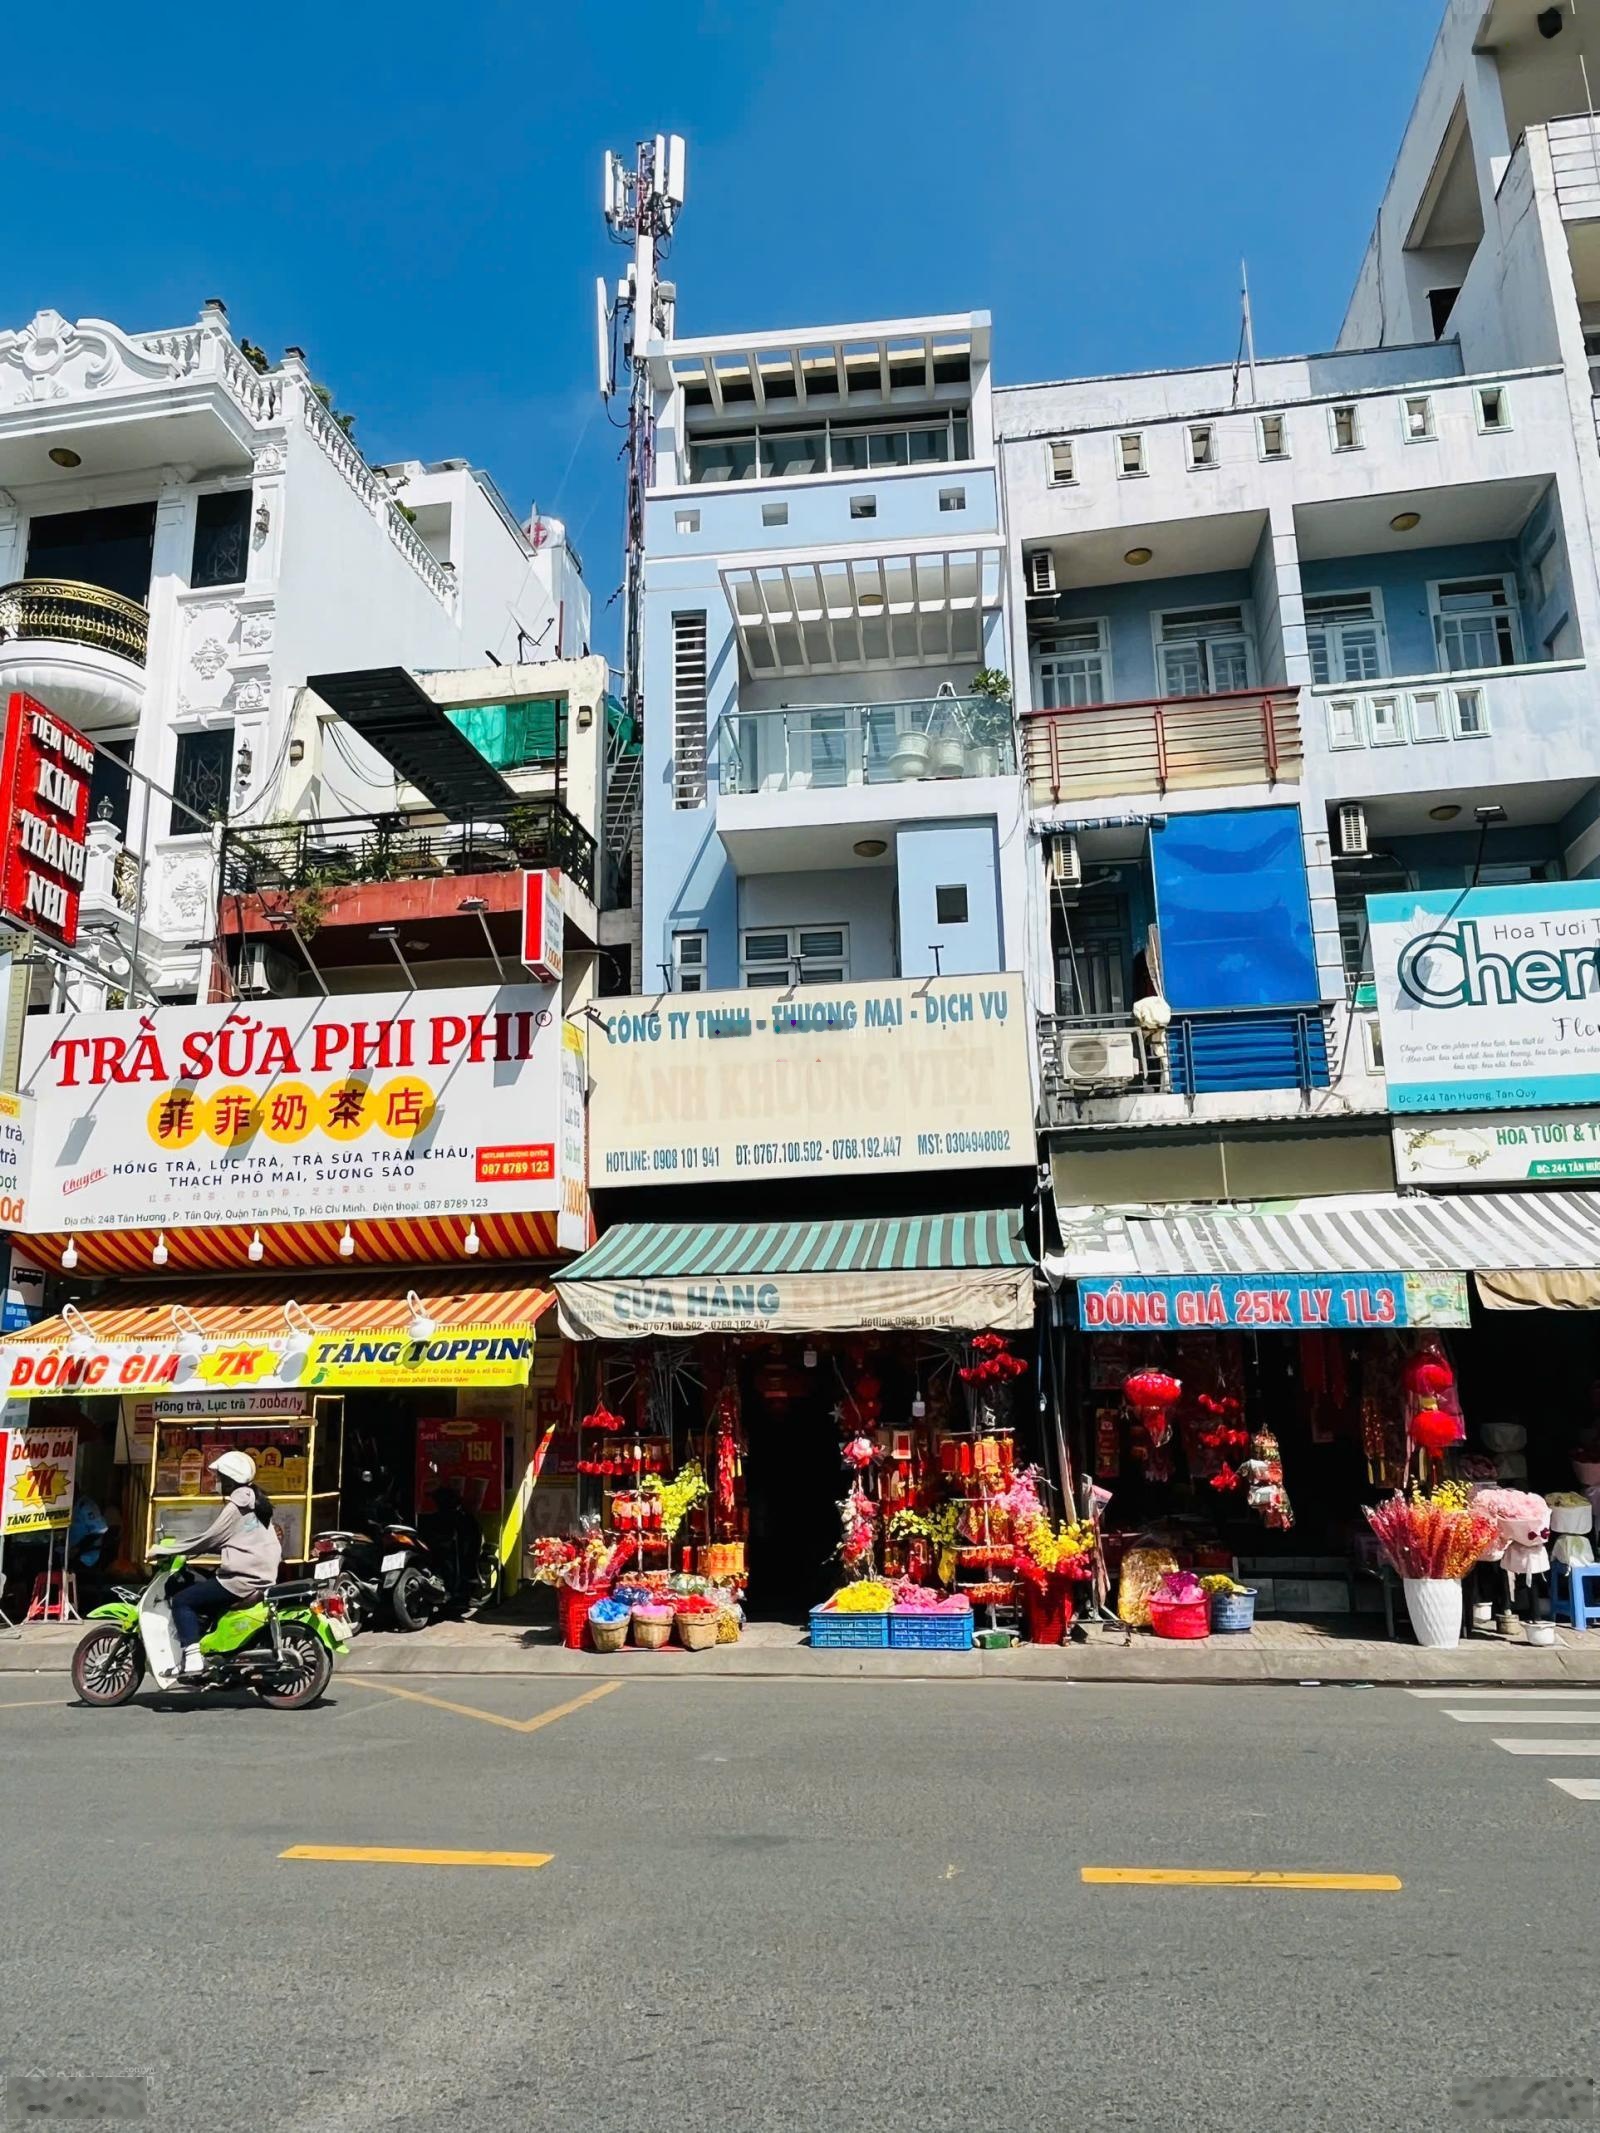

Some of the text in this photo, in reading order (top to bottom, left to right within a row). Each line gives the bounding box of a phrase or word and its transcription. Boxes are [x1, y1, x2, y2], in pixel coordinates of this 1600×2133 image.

[37, 758, 79, 816] KIM
[20, 809, 88, 882] THÀNH
[26, 871, 68, 927] NHI
[1493, 924, 1535, 941] Hoa
[1540, 919, 1587, 938] Tươi
[1397, 920, 1600, 1009] Cher
[606, 1009, 662, 1044] CÔNG
[668, 1012, 691, 1039] TY
[864, 998, 903, 1033] MẠI
[925, 992, 974, 1030] DỊCH
[979, 991, 1009, 1027] VỤ
[1553, 1016, 1600, 1043] Flo
[50, 1015, 169, 1087] TRÀ
[180, 1014, 301, 1080] SỮA
[311, 1018, 416, 1072] PHI
[428, 1012, 534, 1064] PHI
[158, 1088, 424, 1139] 菲菲奶茶店
[606, 1150, 650, 1172] HOTLINE:
[653, 1148, 678, 1170] 0908
[681, 1147, 698, 1168] 101
[702, 1146, 720, 1167] 941
[735, 1144, 751, 1165] ĐT:
[753, 1140, 823, 1165] 0767.100.502
[832, 1136, 902, 1161] 0768.192.447
[917, 1133, 943, 1155] MST:
[946, 1129, 1011, 1154] 0304948082
[1496, 1128, 1528, 1146] HOA
[1573, 1124, 1585, 1142] &
[1588, 1122, 1600, 1141] T
[169, 1175, 222, 1189] THẠCH
[272, 1170, 308, 1183] MAI,
[210, 1158, 241, 1172] LỤC
[482, 1161, 549, 1176] 087 8789 123
[97, 1215, 115, 1225] 248
[424, 1200, 441, 1210] 087
[444, 1199, 468, 1210] 8789
[471, 1198, 488, 1208] 123
[613, 1279, 676, 1320] CỬA
[686, 1278, 781, 1318] HÀNG
[1176, 1283, 1229, 1326] GIÁ
[1235, 1289, 1293, 1325] 25K
[1299, 1288, 1332, 1324] LY
[1342, 1287, 1397, 1324] 1L3
[213, 1350, 265, 1377] 7K
[315, 1338, 403, 1369] TẶNG
[154, 1399, 184, 1414] Hồng
[187, 1399, 205, 1412] trà,
[207, 1399, 228, 1413] Lục
[231, 1398, 245, 1411] trà
[26, 1468, 57, 1499] 7K
